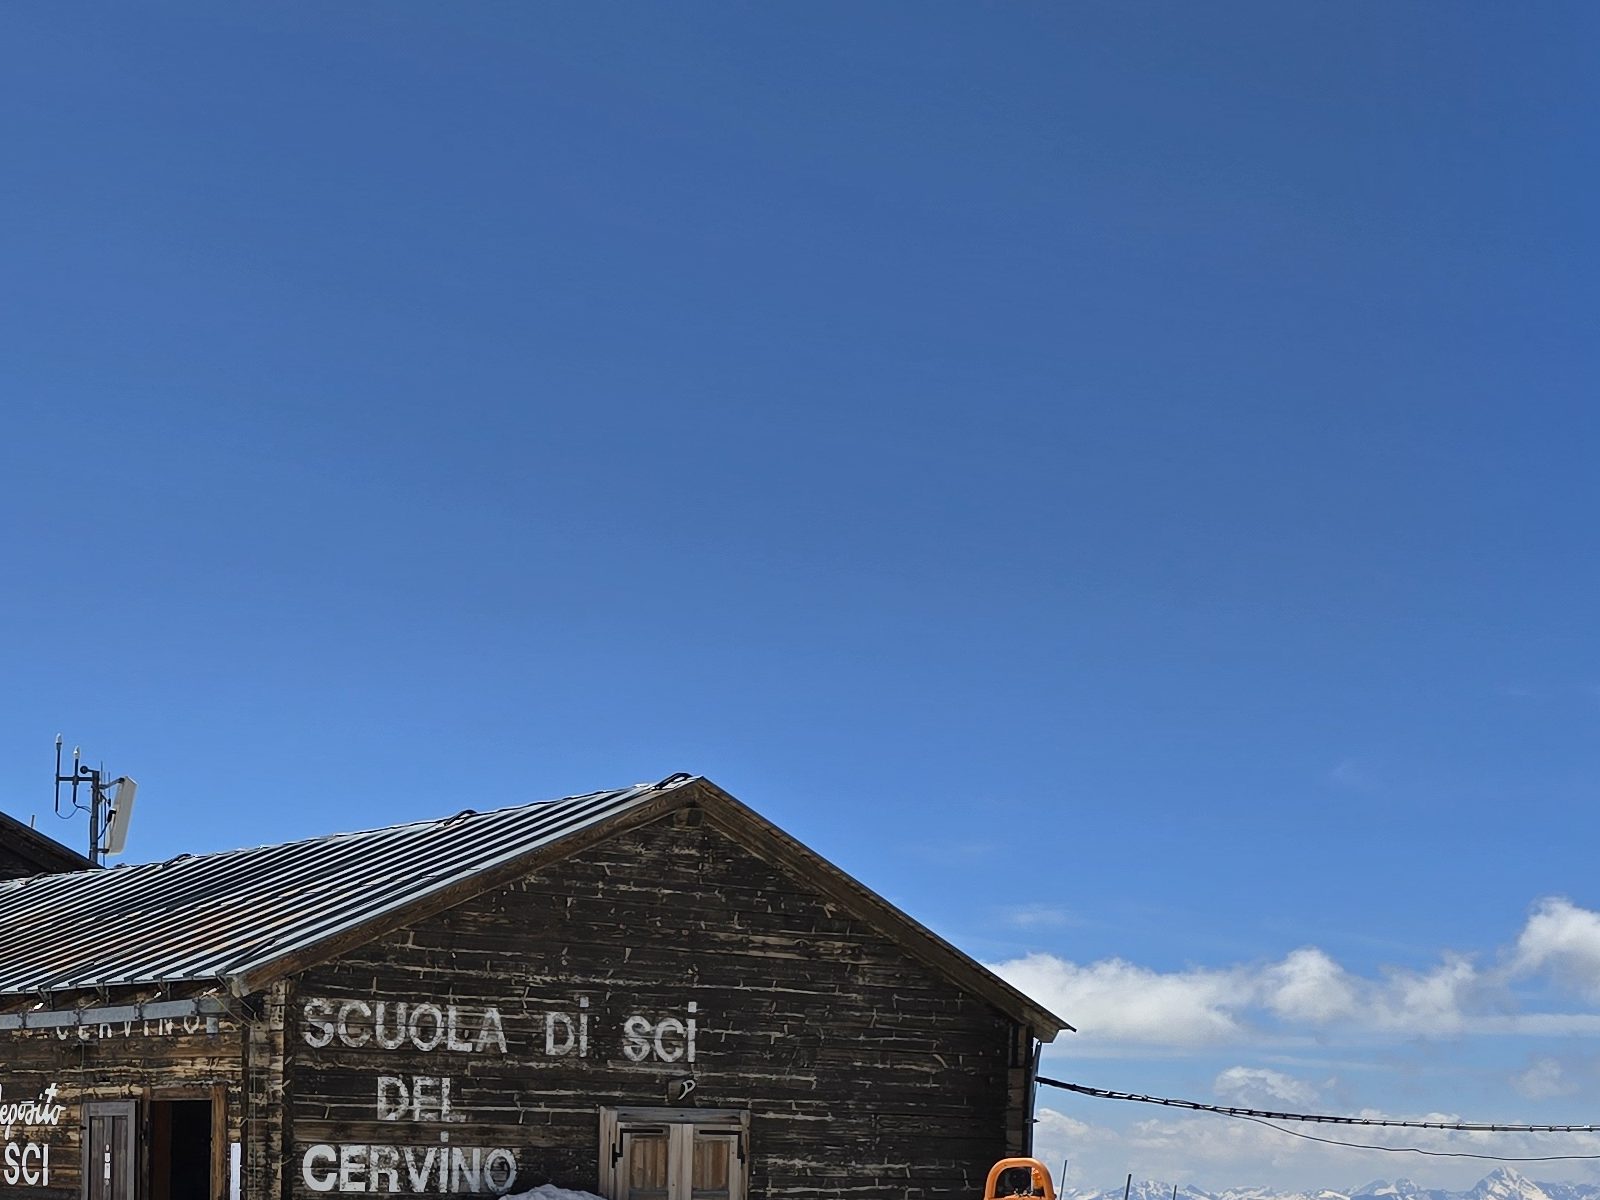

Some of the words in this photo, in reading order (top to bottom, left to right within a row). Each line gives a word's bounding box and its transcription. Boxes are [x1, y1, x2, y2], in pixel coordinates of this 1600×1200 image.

[303, 998, 509, 1054] SCUOLA
[377, 1075, 466, 1122] DEL
[3, 1141, 50, 1187] SCI
